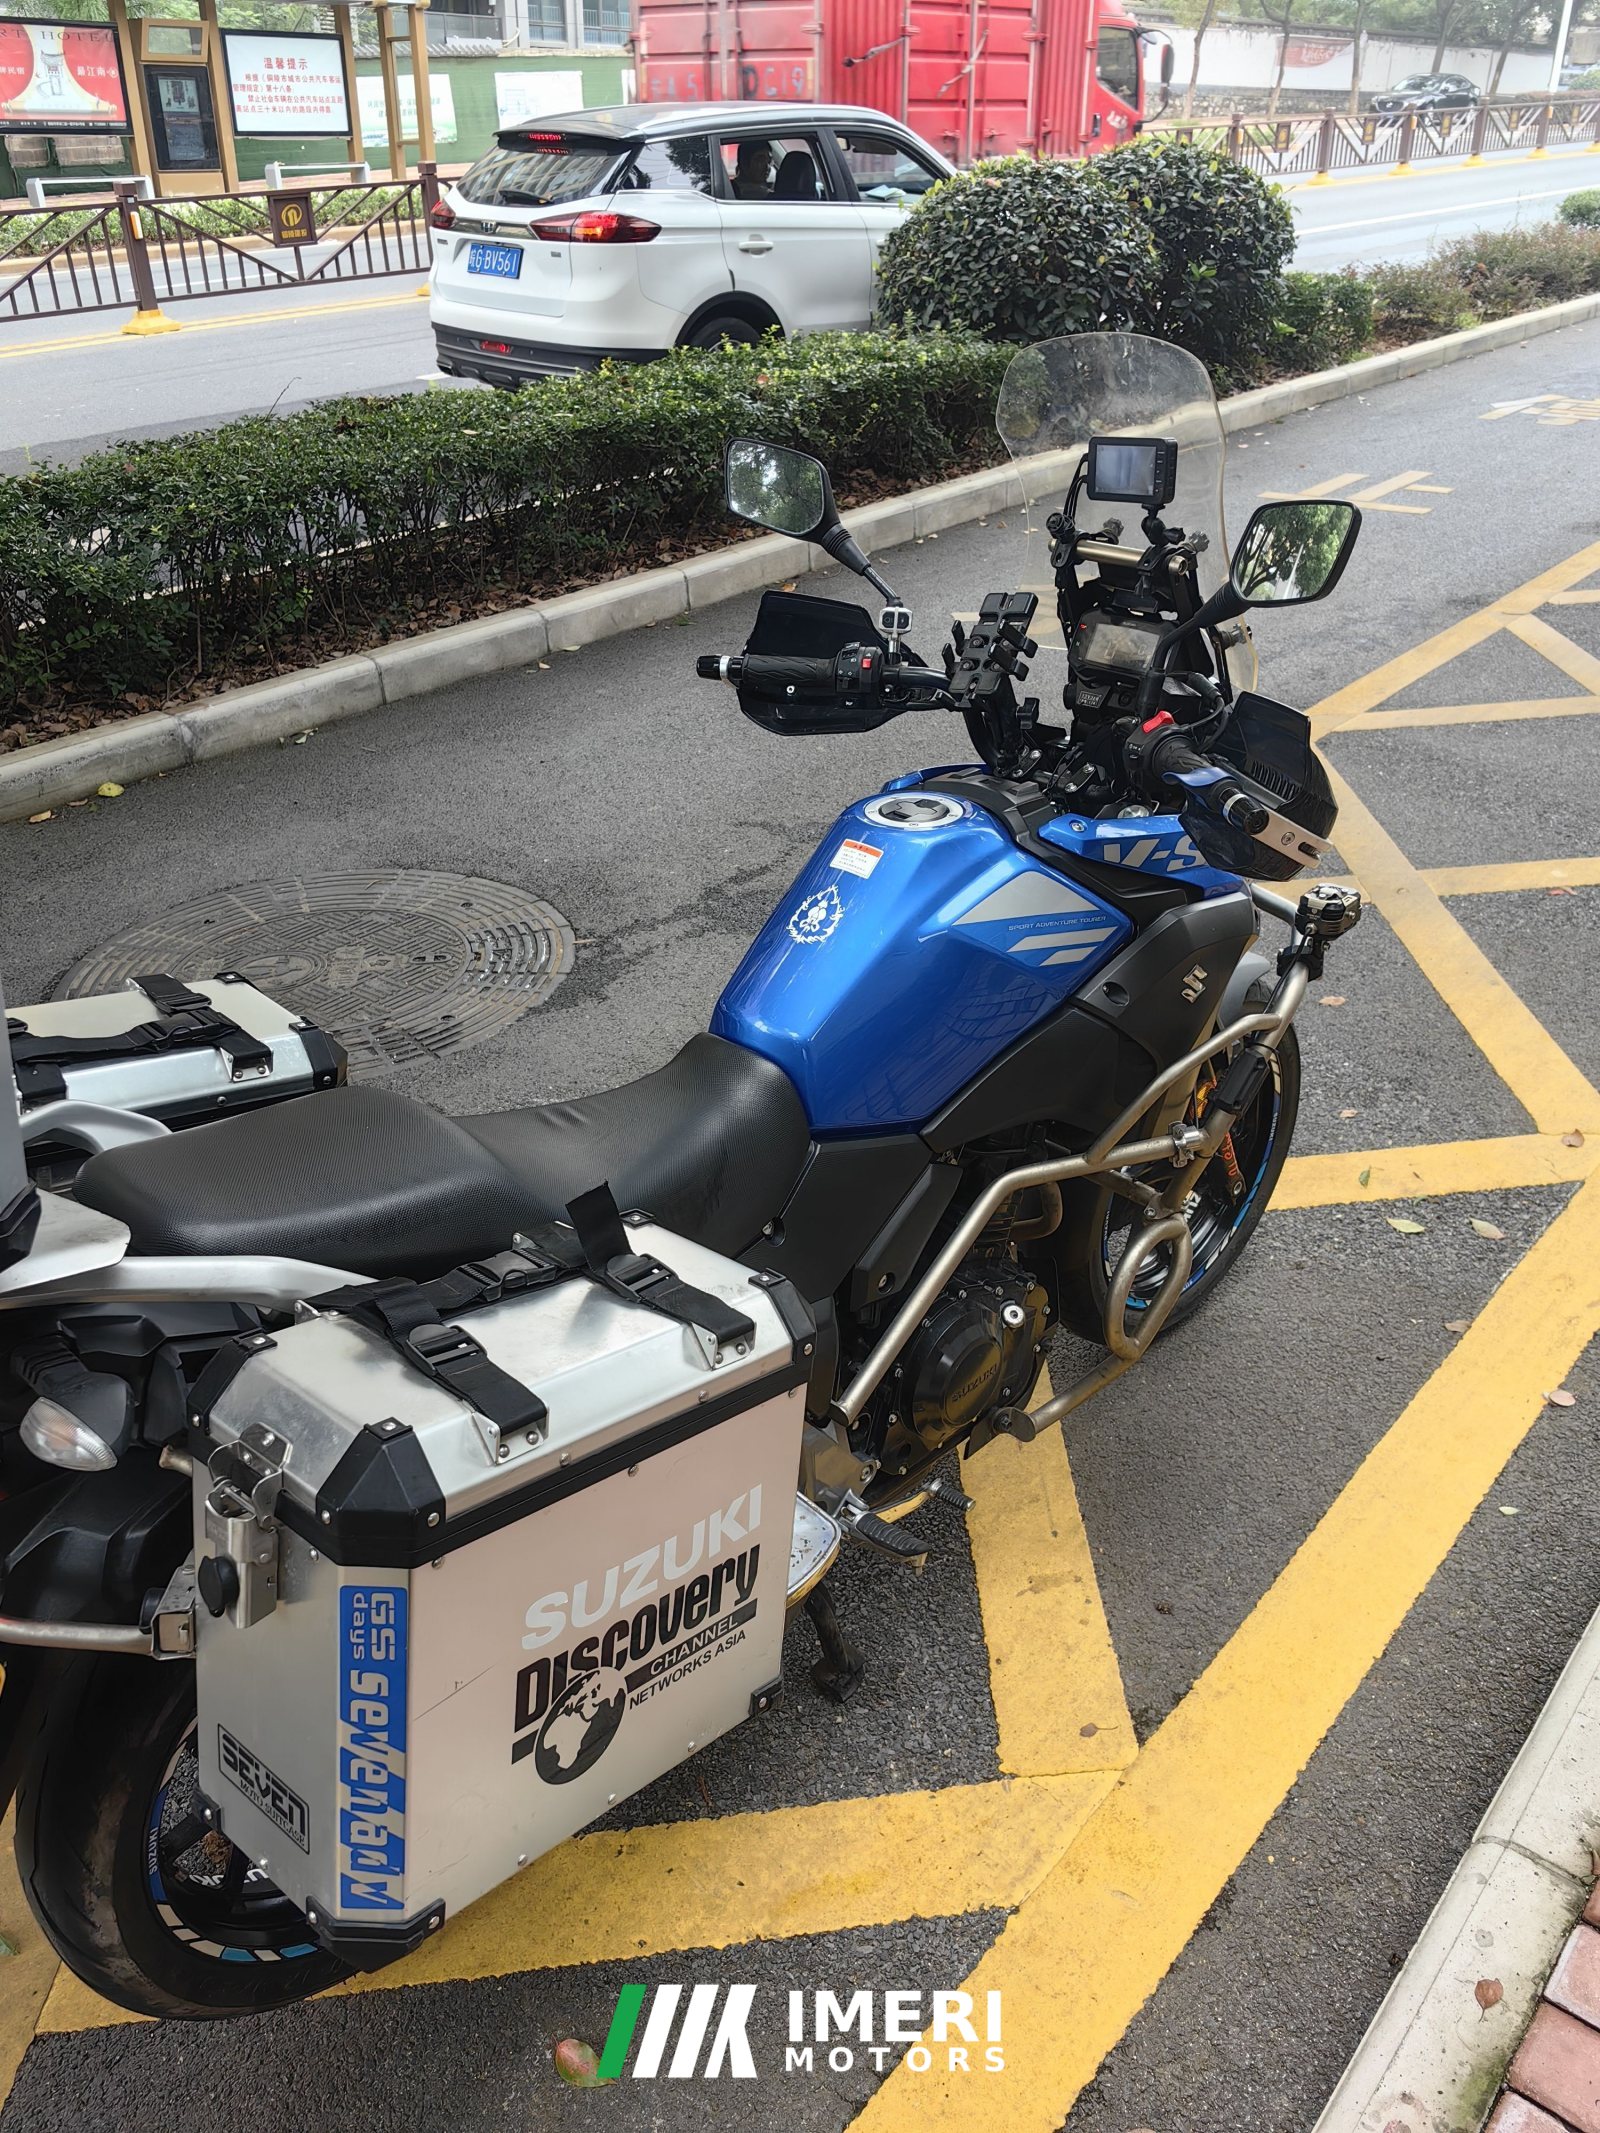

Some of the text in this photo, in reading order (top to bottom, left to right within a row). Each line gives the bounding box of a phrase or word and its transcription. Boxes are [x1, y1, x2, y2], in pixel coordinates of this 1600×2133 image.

[263, 57, 308, 70] 温馨提示
[1008, 915, 1107, 931] SPORT ADVENTURE TOURER
[522, 1483, 762, 1650] SUZUKI
[350, 1592, 369, 1660] days
[650, 1614, 739, 1676] CHANNEL
[629, 1629, 746, 1710] NETWORKS ASIA
[239, 1779, 306, 1848] MOTO SUITCASE
[148, 1826, 159, 1875] SUZUKI
